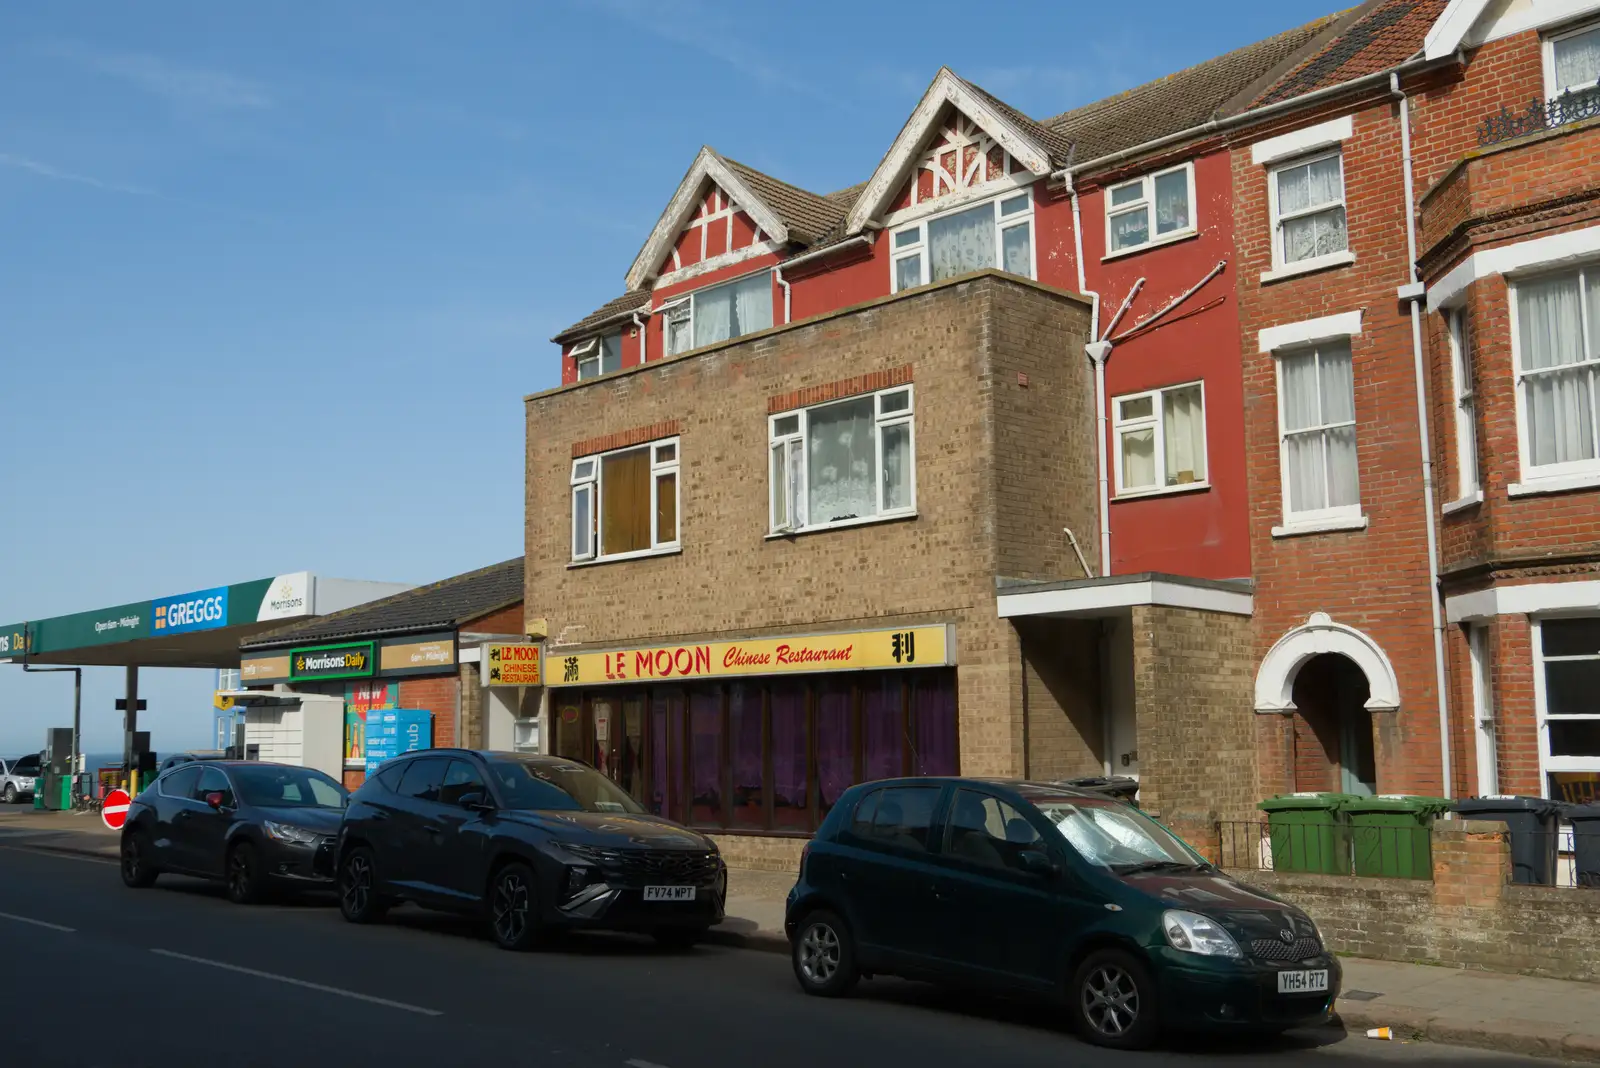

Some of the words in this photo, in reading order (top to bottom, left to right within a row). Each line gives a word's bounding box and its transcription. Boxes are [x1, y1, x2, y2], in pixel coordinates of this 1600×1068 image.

[168, 596, 222, 627] GREGGS
[270, 597, 303, 610] Morrisons
[95, 621, 107, 634] Open
[120, 615, 140, 629] Midnight
[502, 647, 512, 660] LE
[514, 647, 539, 660] MOON
[892, 631, 915, 663] 利
[305, 653, 345, 670] Morrisons
[345, 651, 365, 670] Daily
[426, 651, 449, 662] Midnight
[605, 653, 627, 680] LE
[635, 646, 711, 678] MOON
[723, 646, 771, 668] Chinese
[776, 644, 853, 666] Restaurant
[504, 663, 538, 672] CHINESE
[502, 673, 540, 683] RESTAURANT
[406, 724, 419, 752] hub
[674, 887, 692, 898] WPT
[1282, 973, 1307, 989] YH54
[1308, 972, 1324, 988] RTZ
